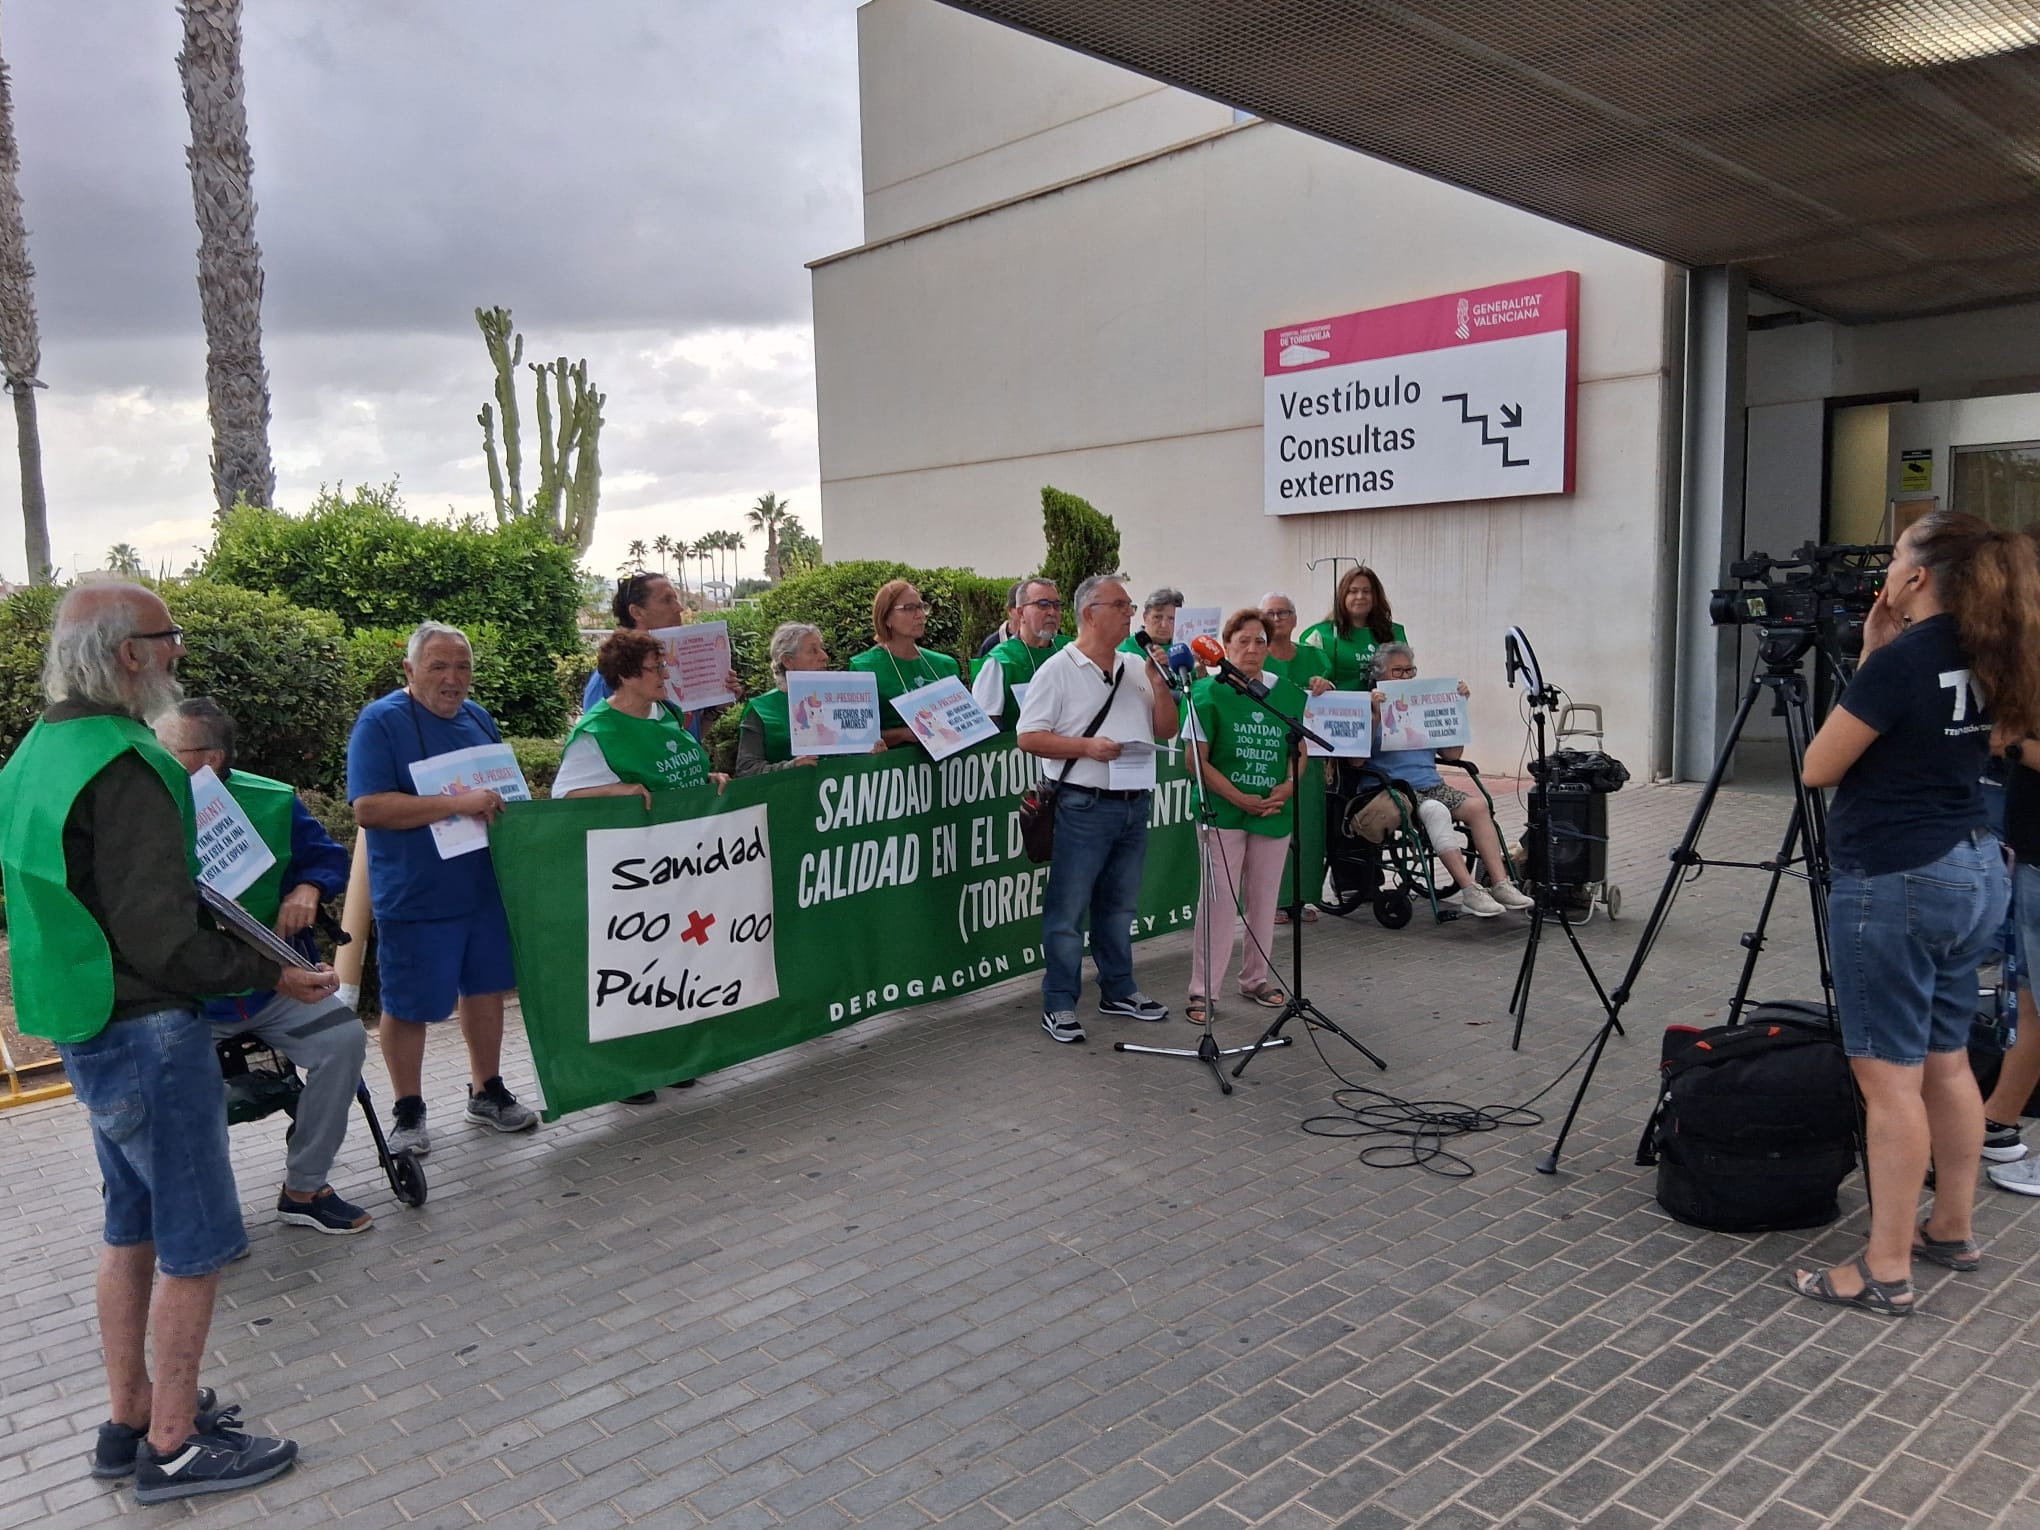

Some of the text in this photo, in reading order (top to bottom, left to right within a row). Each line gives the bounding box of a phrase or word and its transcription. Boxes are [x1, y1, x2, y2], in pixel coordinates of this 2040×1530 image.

[1473, 294, 1542, 315] GENERALITAT
[1474, 308, 1540, 327] VALENCIANA
[1290, 329, 1331, 345] TORREVIEJA
[1280, 375, 1421, 419] Vestíbulo
[1280, 424, 1416, 462] Consultas
[1280, 469, 1394, 499] externas
[1233, 722, 1282, 738] SANIDAD
[1236, 735, 1253, 744] 100
[1264, 738, 1280, 748] 100
[656, 748, 700, 773] SANIDAD
[1235, 745, 1278, 762] PÚBLICA
[1256, 762, 1268, 774] DE
[1231, 771, 1277, 788] CALIDAD
[815, 763, 932, 832] SANIDAD
[612, 825, 766, 890] Sanidad
[798, 833, 920, 909] CALIDAD
[932, 823, 957, 878] EN
[971, 815, 999, 867] EL
[959, 867, 1050, 944] (TORRE
[607, 911, 671, 942] 100
[729, 913, 772, 943] 100
[829, 955, 1010, 1022] DEROGACIÓN
[1169, 904, 1193, 924] 15
[596, 958, 742, 1011] Pública
